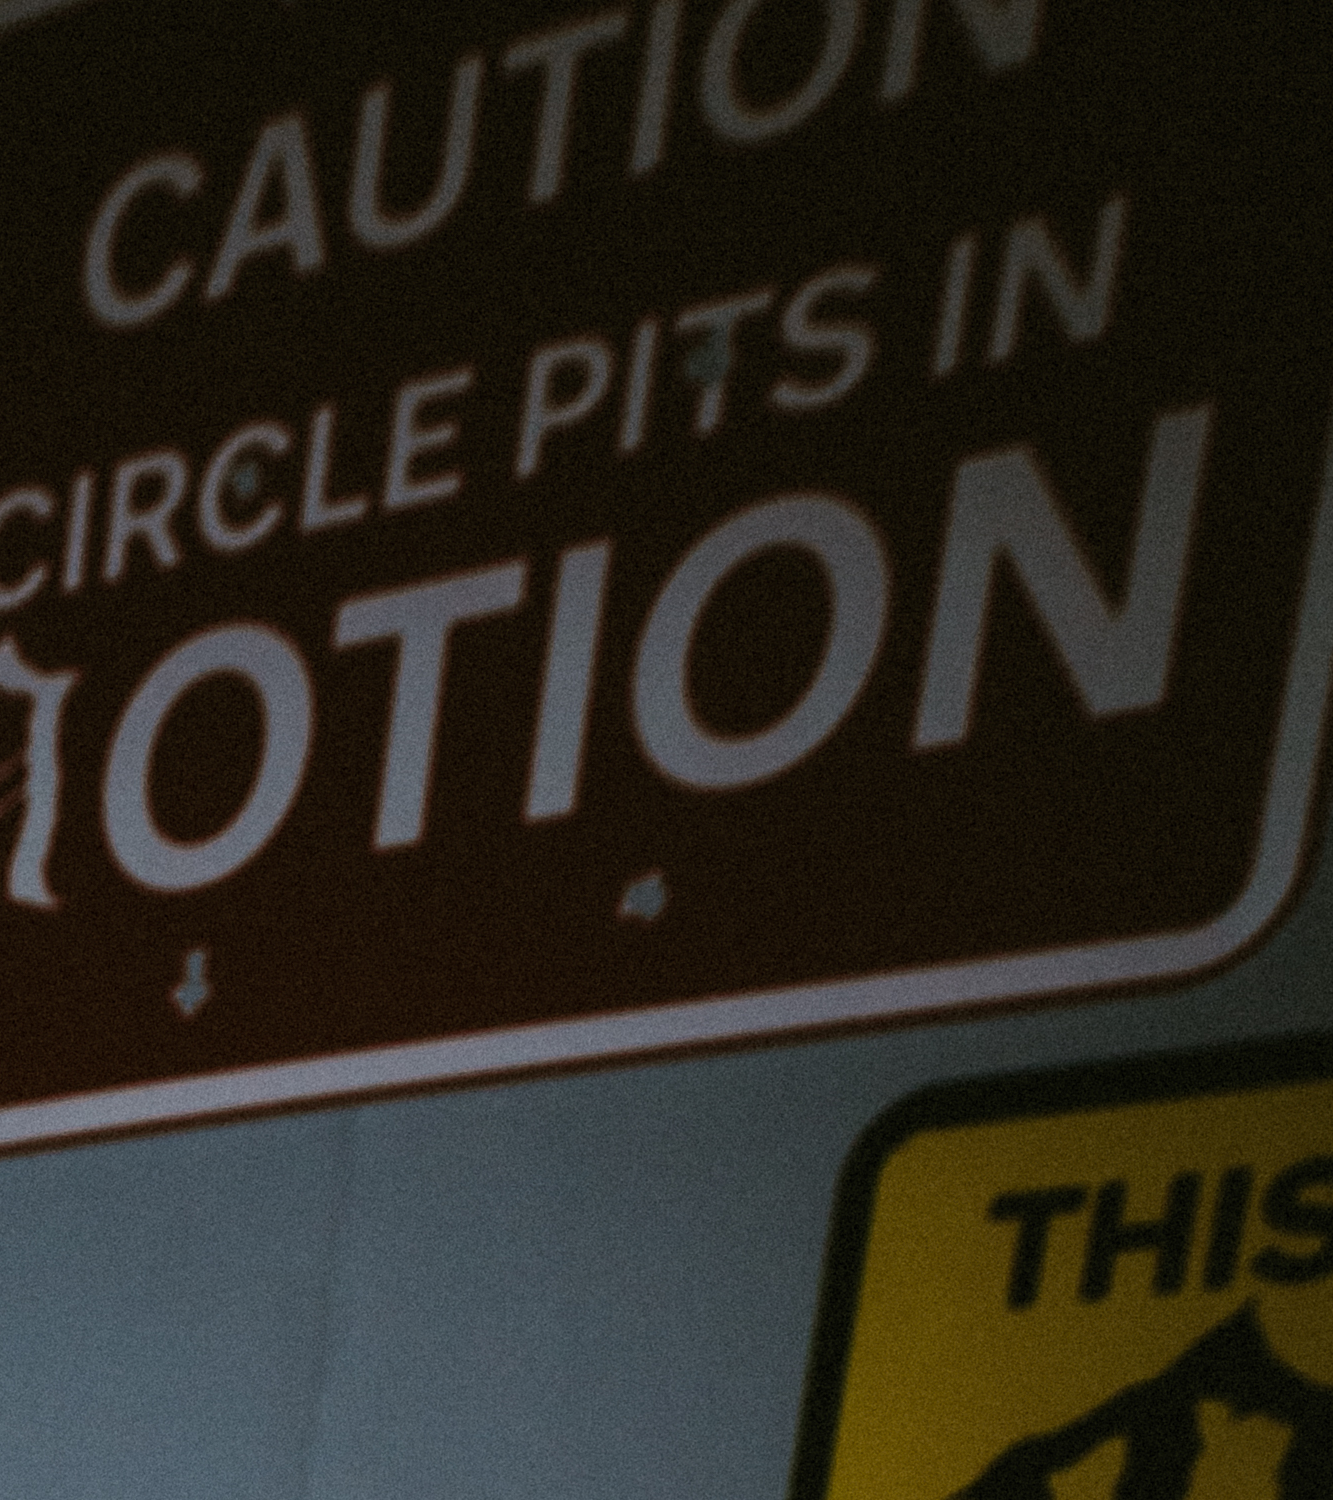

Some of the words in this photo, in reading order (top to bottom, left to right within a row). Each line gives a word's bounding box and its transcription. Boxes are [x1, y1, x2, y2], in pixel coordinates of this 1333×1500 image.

[81, 0, 1041, 327] CAUTION
[516, 263, 878, 478] PITS
[931, 193, 1128, 379] IN
[989, 1155, 1333, 1313] THIS
